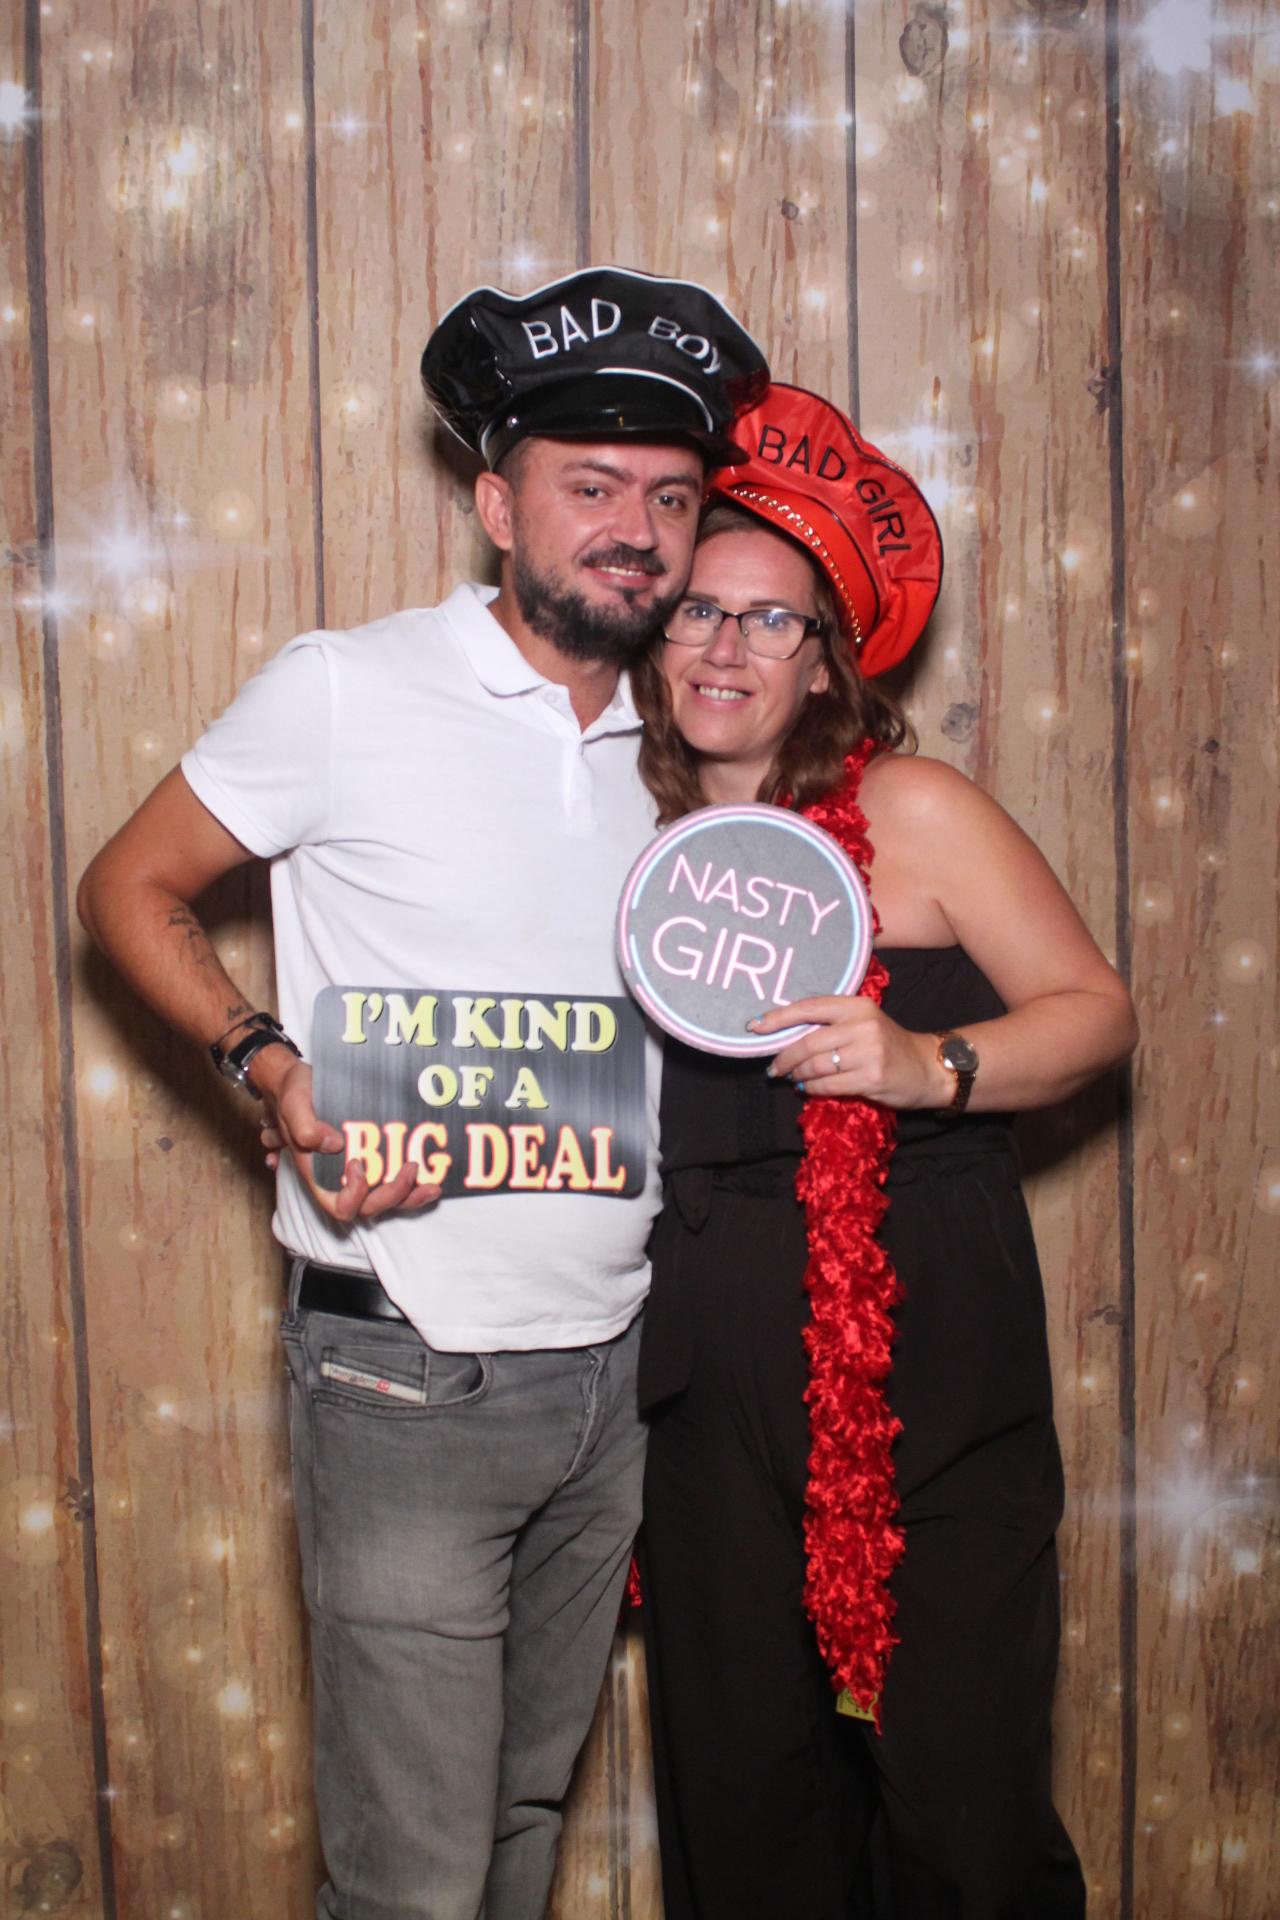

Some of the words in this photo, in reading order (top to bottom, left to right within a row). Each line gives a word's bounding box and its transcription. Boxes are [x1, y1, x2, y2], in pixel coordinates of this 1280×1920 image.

[521, 298, 622, 359] BAD
[757, 424, 847, 482] BAD
[855, 478, 912, 557] GIRL
[668, 853, 841, 936] NASTY
[652, 916, 796, 1006] GIRL
[451, 997, 617, 1052] KIND
[417, 1064, 495, 1108] OF
[504, 1066, 550, 1109] A
[341, 1121, 452, 1188] BIG
[463, 1123, 626, 1191] DEAL
